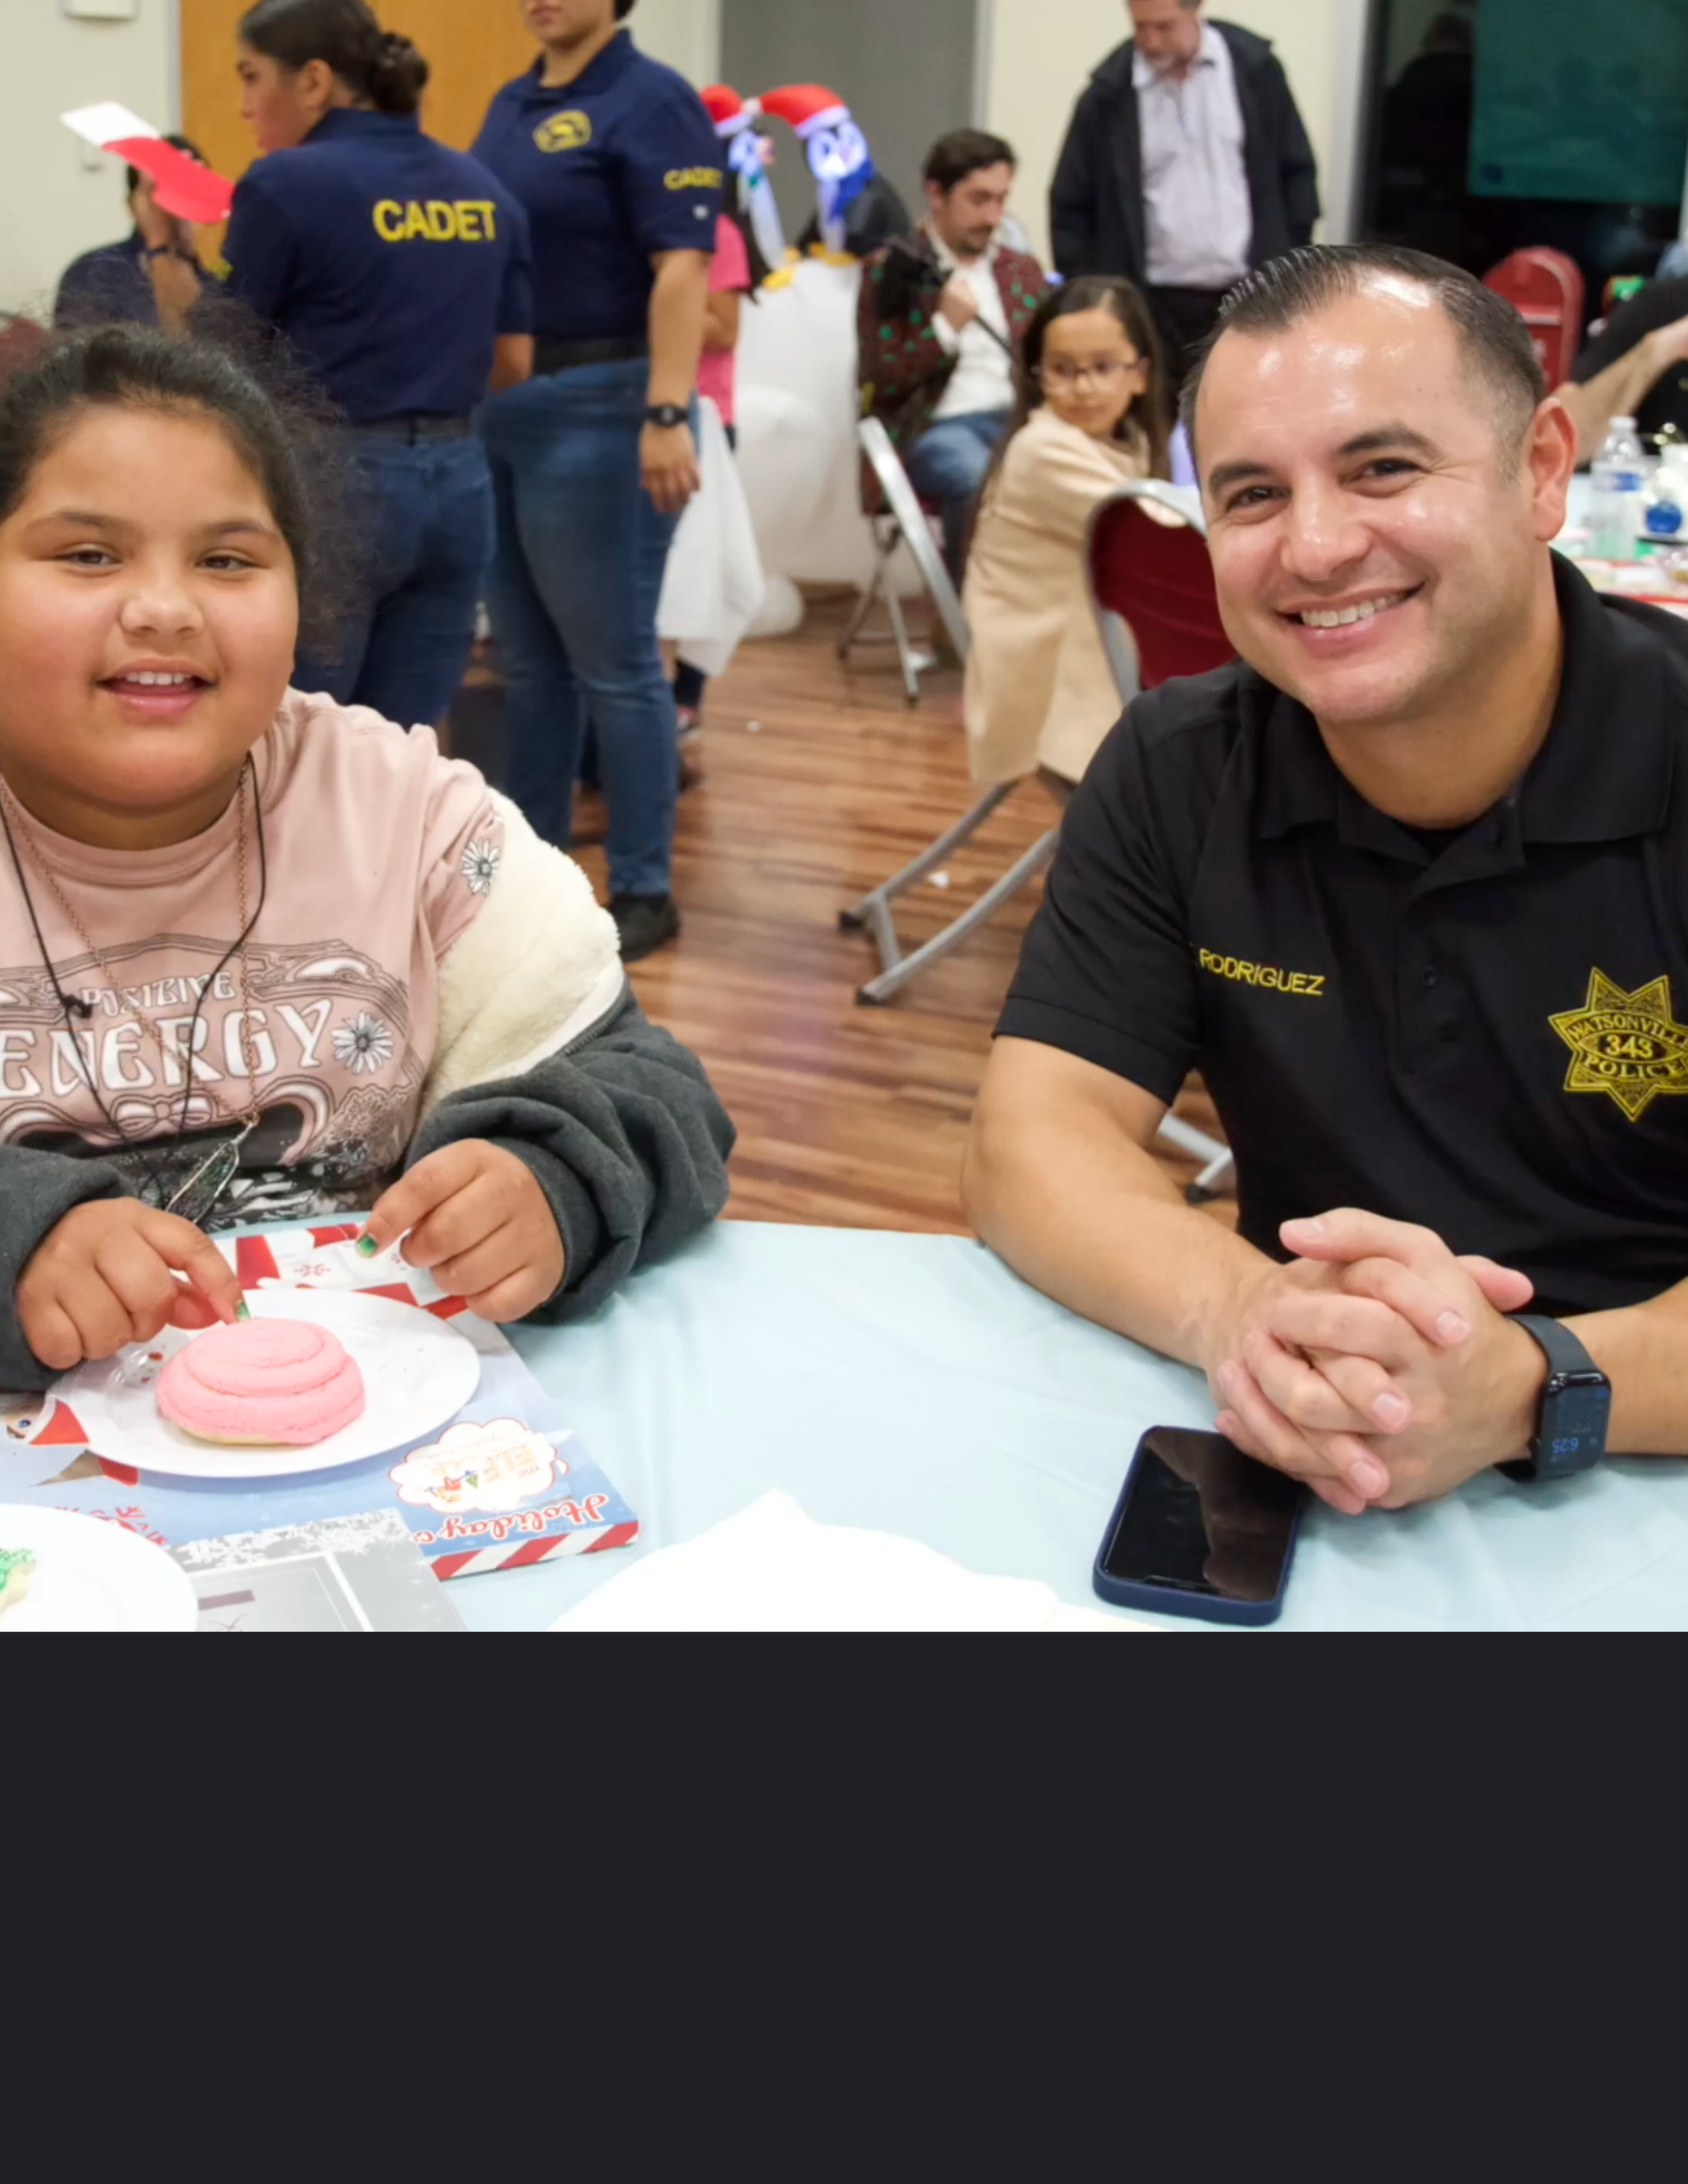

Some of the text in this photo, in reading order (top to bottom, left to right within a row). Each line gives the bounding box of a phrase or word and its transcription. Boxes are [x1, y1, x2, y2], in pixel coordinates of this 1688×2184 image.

[373, 198, 496, 242] CADET
[81, 971, 235, 1017] POSITIVE
[1199, 948, 1325, 996] RODRIGUEZ
[0, 998, 333, 1099] ENERGY
[1584, 1053, 1682, 1078] POLICE
[440, 1495, 608, 1539] Holiday
